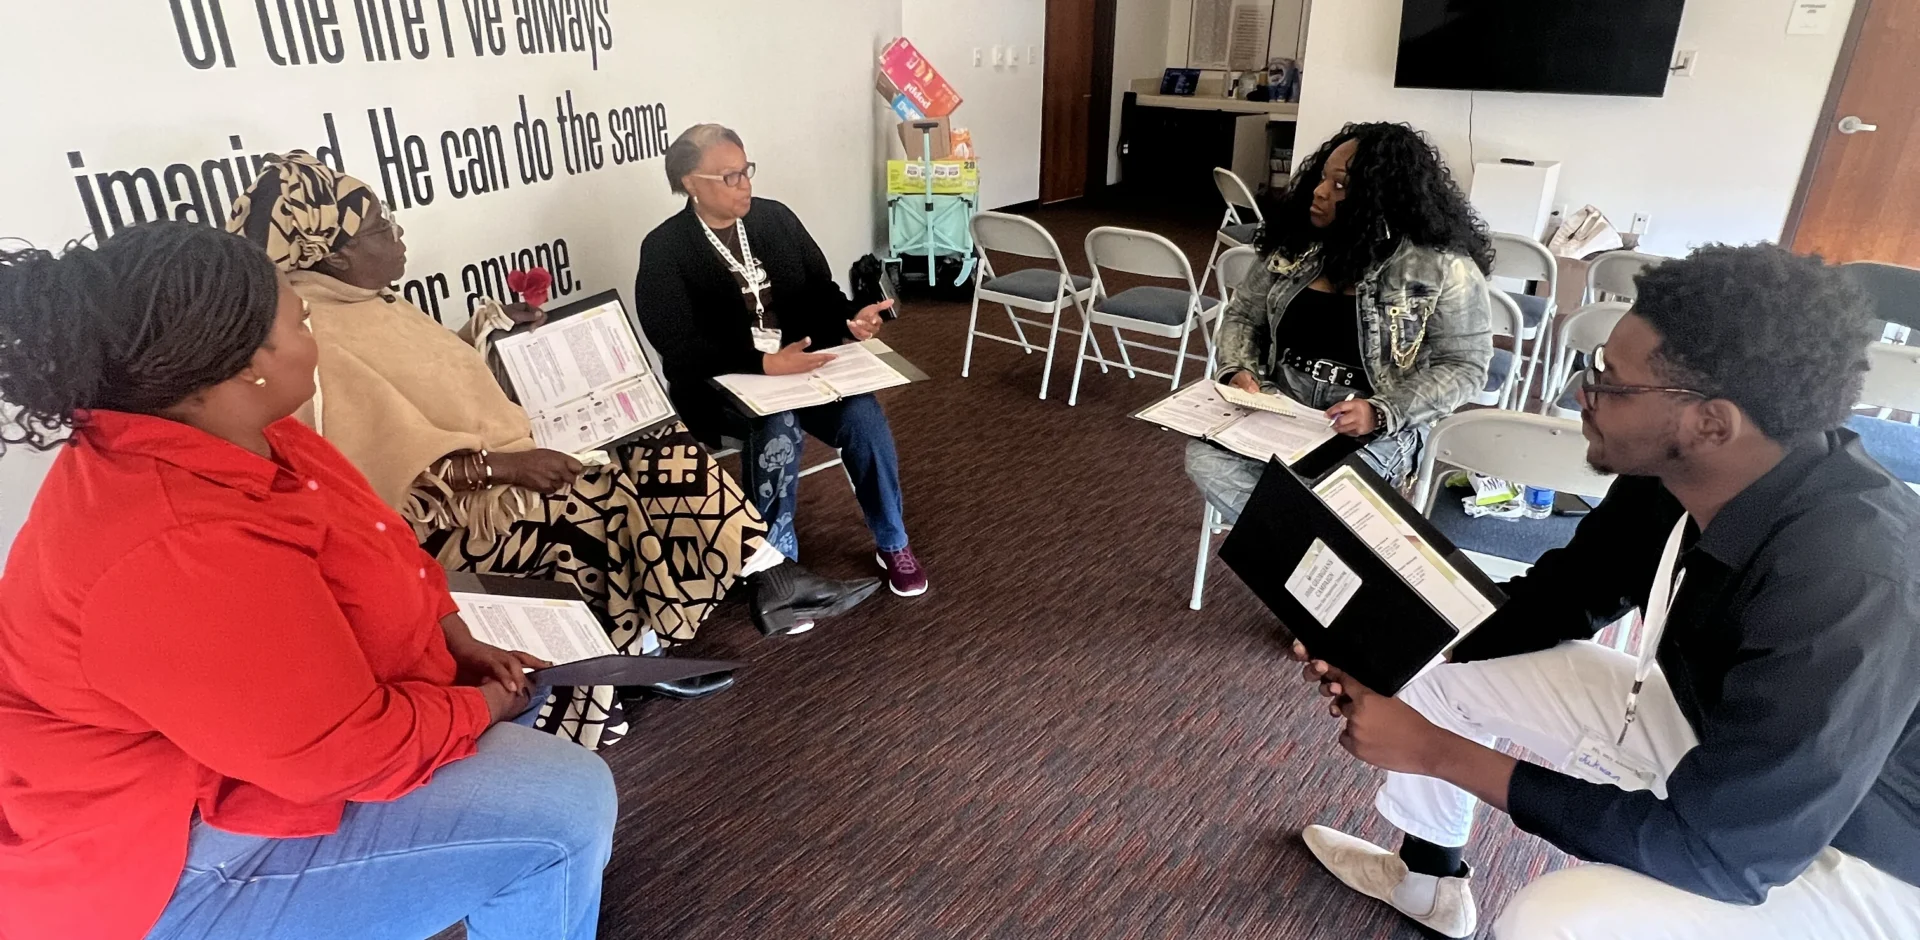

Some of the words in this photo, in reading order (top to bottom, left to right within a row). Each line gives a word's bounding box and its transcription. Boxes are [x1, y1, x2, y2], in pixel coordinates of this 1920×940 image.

[254, 0, 345, 66] the
[512, 0, 613, 71] always
[367, 107, 435, 211] He
[440, 124, 510, 199] can
[513, 94, 554, 185] do
[555, 90, 604, 175] the
[608, 102, 671, 165] same
[963, 161, 975, 170] 28
